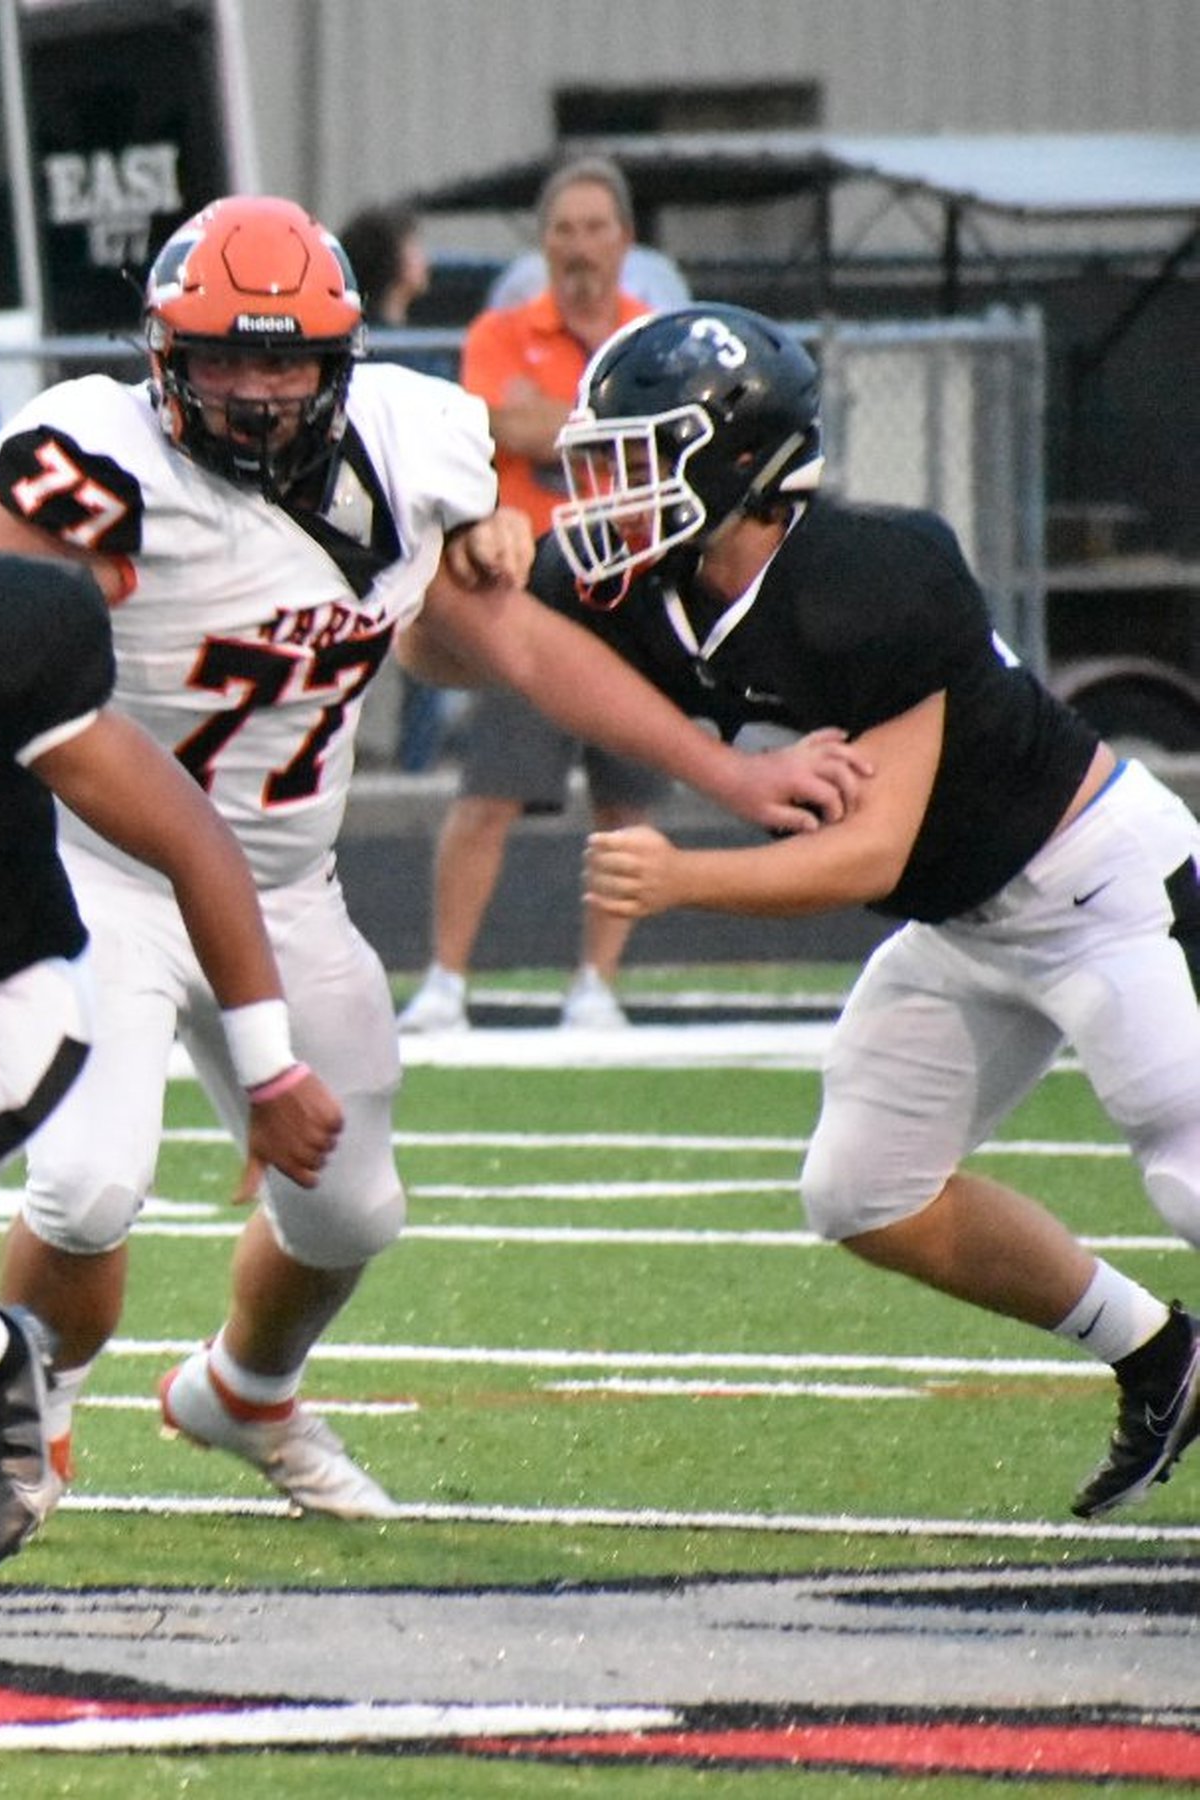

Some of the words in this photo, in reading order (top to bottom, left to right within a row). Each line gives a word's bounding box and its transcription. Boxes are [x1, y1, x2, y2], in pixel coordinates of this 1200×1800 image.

[44, 143, 181, 223] EASI
[689, 316, 748, 370] 3
[11, 437, 130, 548] 77
[173, 625, 397, 808] 77
